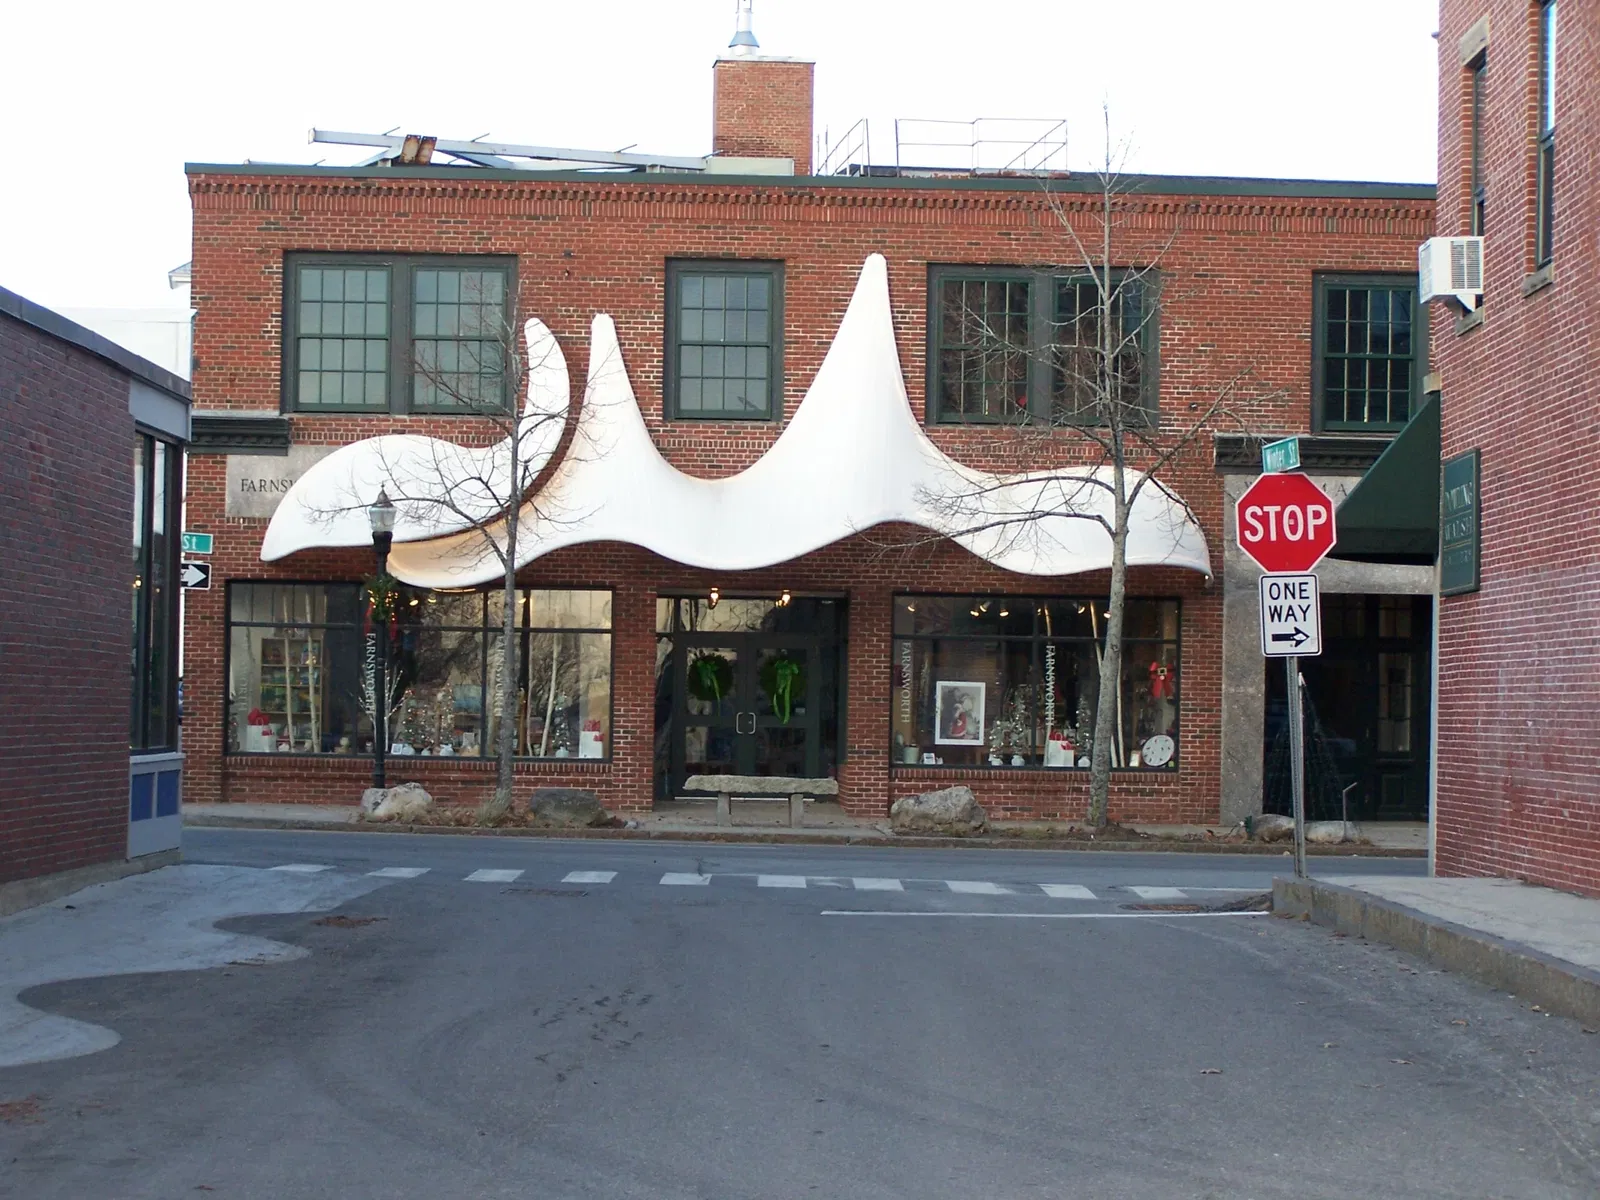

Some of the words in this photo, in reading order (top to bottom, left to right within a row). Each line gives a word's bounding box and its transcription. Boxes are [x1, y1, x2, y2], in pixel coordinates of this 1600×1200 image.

[1244, 504, 1328, 542] STOP
[182, 535, 197, 550] St
[1269, 582, 1310, 600] ONE
[1269, 604, 1311, 623] WAY
[365, 633, 376, 715] FARNSWORTH
[901, 642, 912, 723] FARNSWORTH
[1045, 645, 1056, 726] FARNSWORTH
